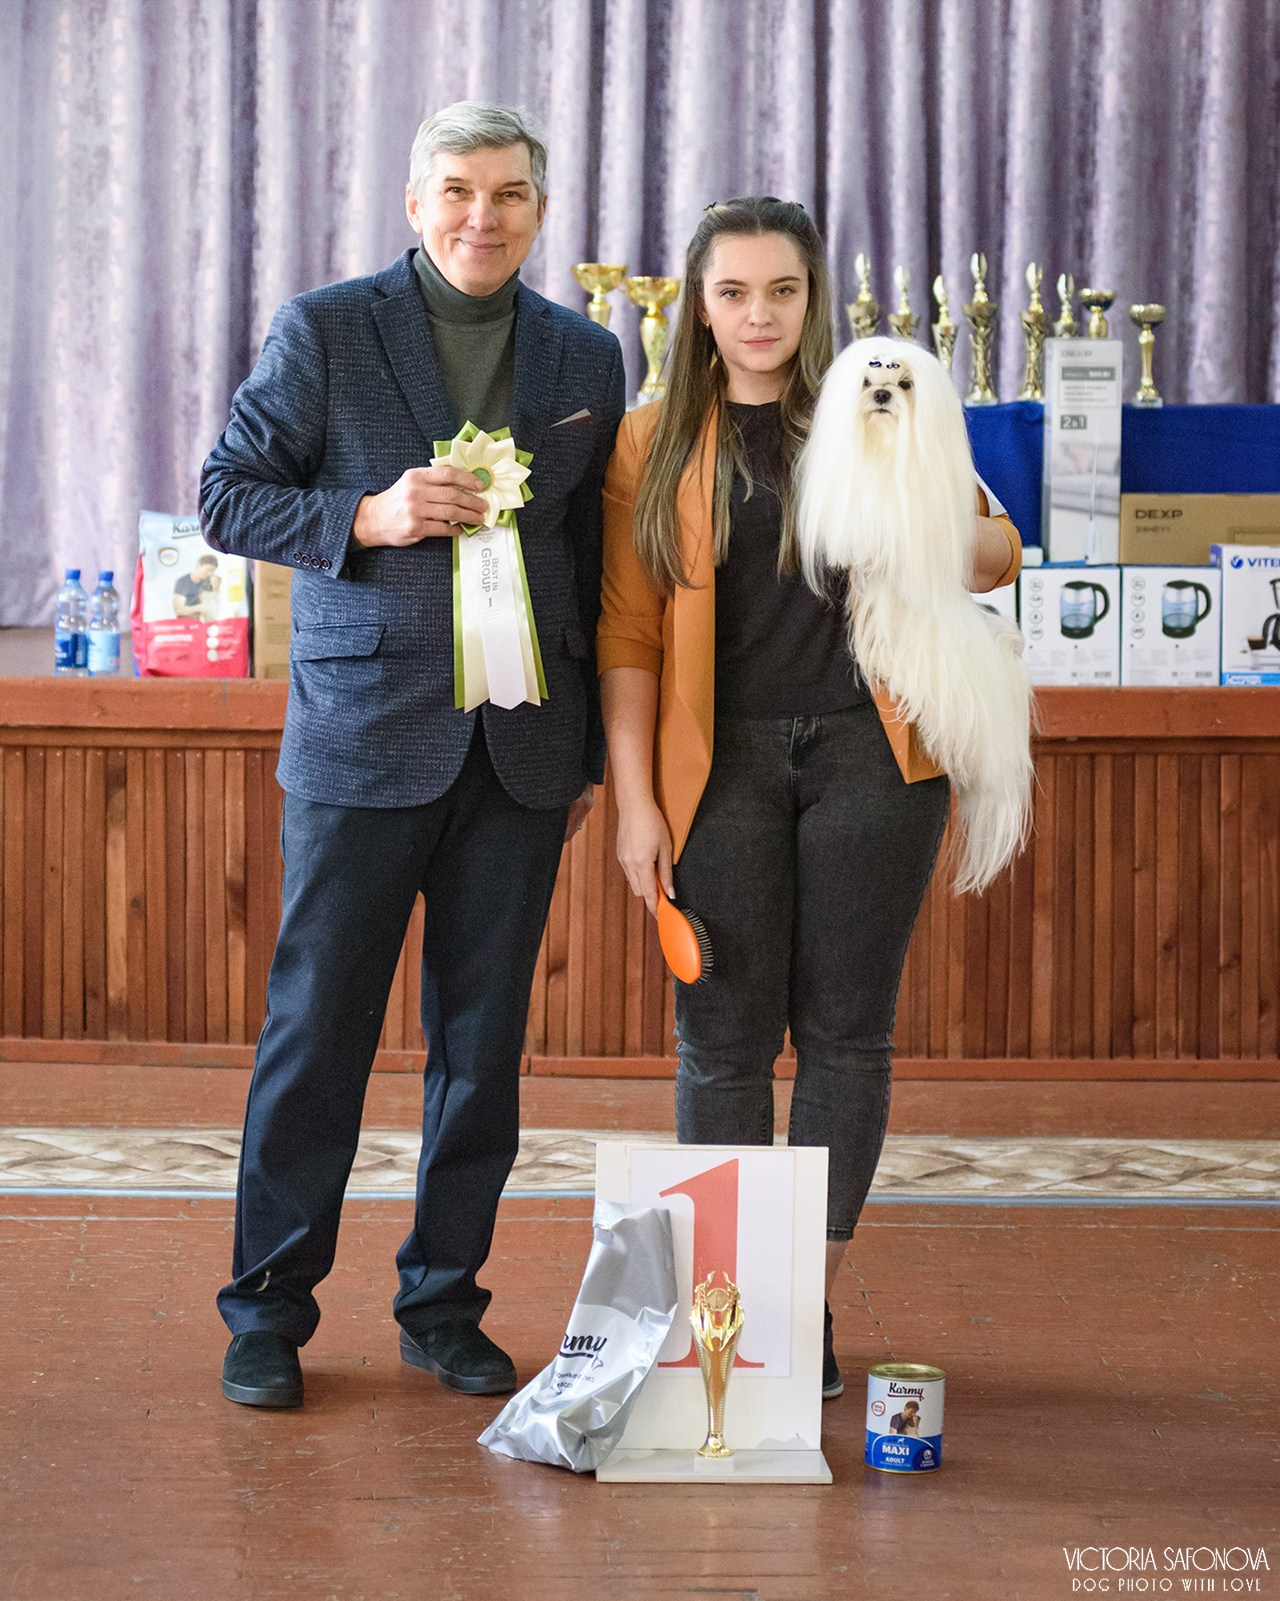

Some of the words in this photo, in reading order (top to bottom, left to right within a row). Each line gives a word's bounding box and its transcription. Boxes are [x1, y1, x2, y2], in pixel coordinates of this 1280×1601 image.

[1135, 509, 1184, 520] DEXP
[1247, 557, 1280, 567] VITE
[481, 548, 492, 593] GROUP
[492, 582, 499, 591] IN
[657, 1158, 765, 1368] 1
[888, 1382, 925, 1401] Karmy
[882, 1445, 910, 1456] MAXI
